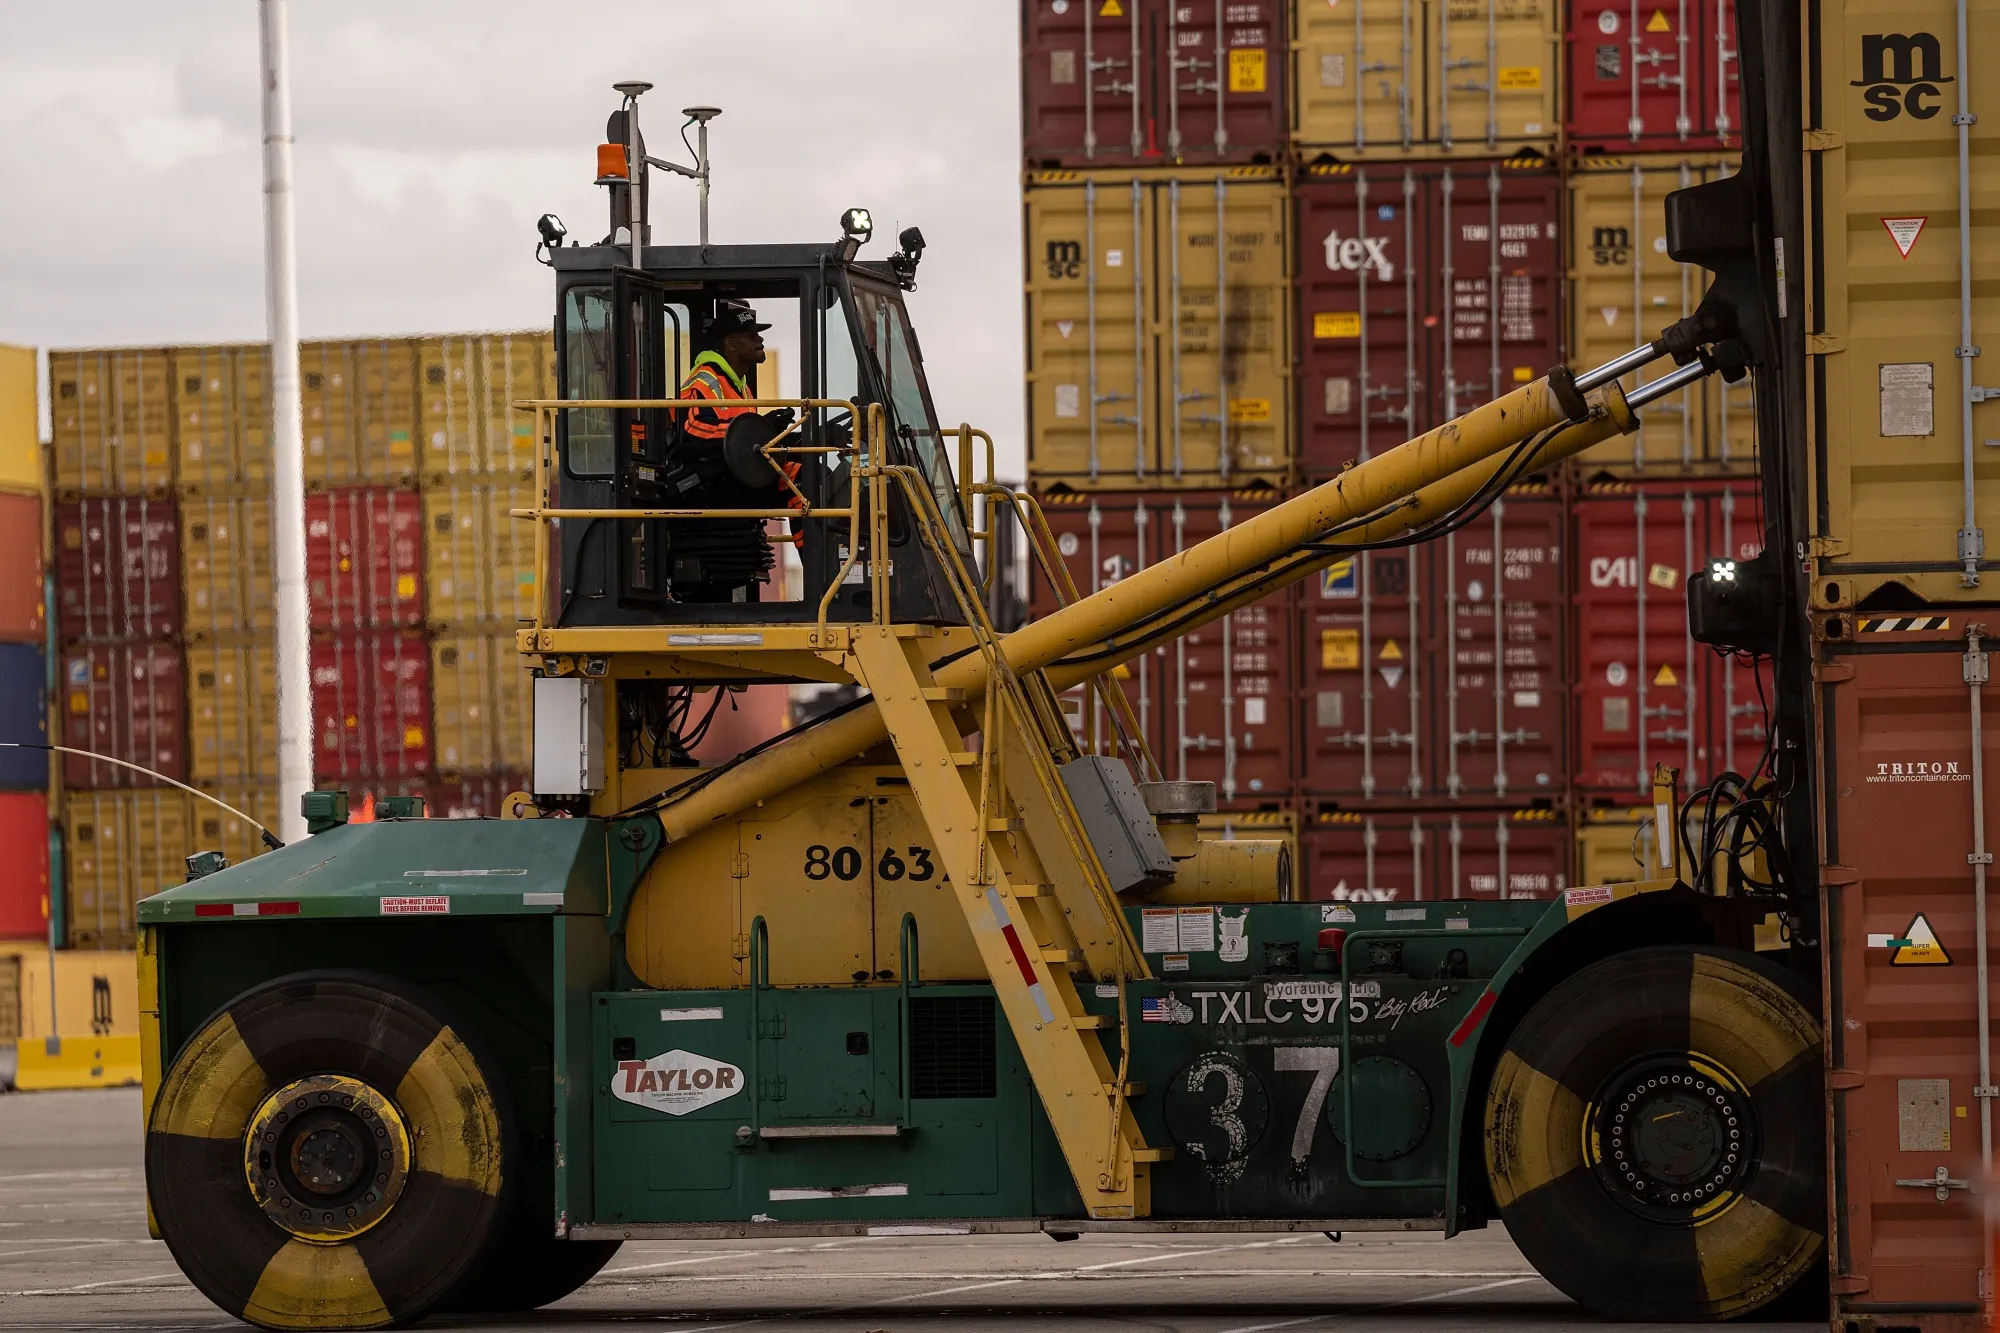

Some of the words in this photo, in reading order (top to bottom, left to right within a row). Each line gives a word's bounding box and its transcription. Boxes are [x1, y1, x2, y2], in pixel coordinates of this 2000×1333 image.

[1461, 225, 1489, 241] TEMU
[1323, 229, 1392, 272] tex
[1590, 556, 1638, 588] CAI
[1877, 762, 1959, 775] TRITON
[1866, 773, 1971, 783] www.tritoncontainer.com
[878, 846, 950, 883] 63
[1469, 876, 1498, 892] TEMU
[384, 905, 400, 913] TIRES
[421, 904, 447, 912] REMOVAL
[1266, 982, 1335, 998] Hydraulic
[1349, 983, 1377, 995] luid
[1192, 991, 1294, 1024] TXLC
[1301, 997, 1369, 1024] 975
[619, 1061, 736, 1093] TAYLOR
